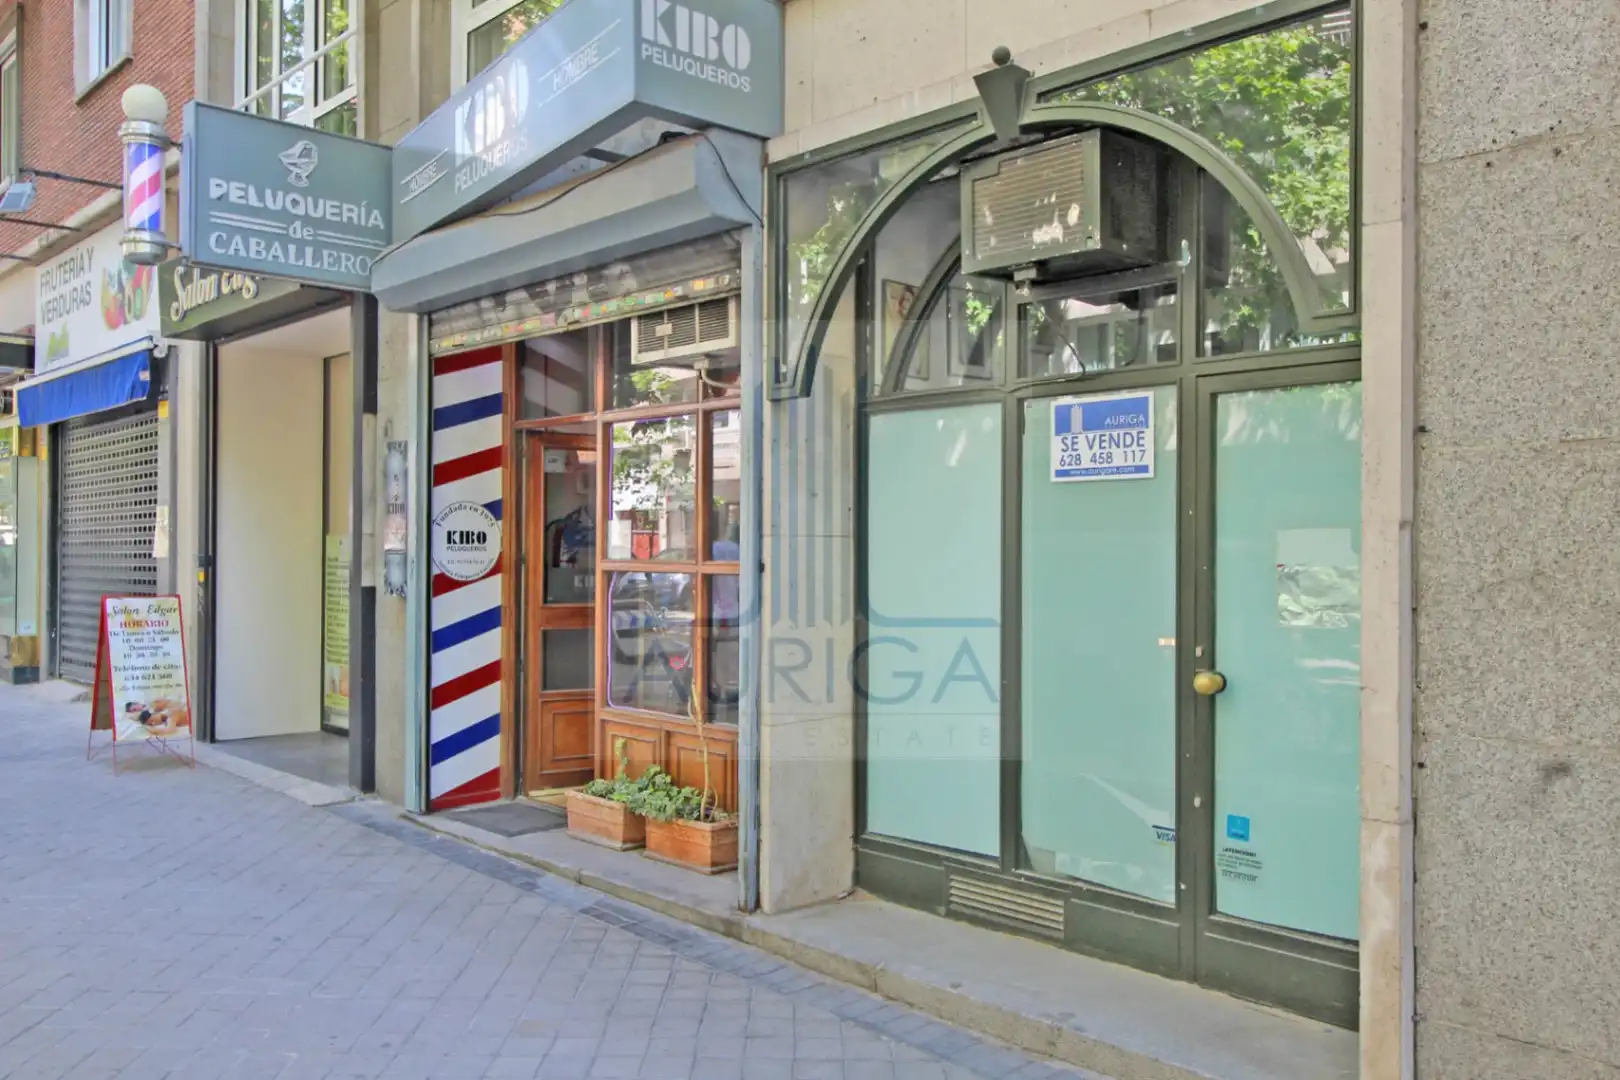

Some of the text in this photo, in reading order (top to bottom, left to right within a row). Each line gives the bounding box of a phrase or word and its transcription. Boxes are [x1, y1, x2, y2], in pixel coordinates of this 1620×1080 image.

[641, 0, 752, 70] KIBO
[552, 43, 600, 90] HOMBRE
[641, 43, 752, 93] PELUQUEROS
[455, 58, 530, 168] KIBO
[455, 126, 528, 195] PELUQUEROS
[209, 177, 385, 230] PELUQUERÍA
[288, 220, 315, 240] de
[40, 245, 95, 298] FRUTERÍA Y
[209, 231, 372, 276] CABALLERO
[41, 280, 92, 325] VERDURAS
[170, 265, 219, 322] Salon
[1061, 430, 1146, 453] SE VENDE
[1105, 414, 1146, 425] AURIGA
[1059, 449, 1146, 467] 628 458 117
[446, 530, 488, 545] KIBO
[119, 620, 169, 629] HORARIO
[146, 603, 178, 617] Edgar
[1156, 831, 1177, 842] VISA
